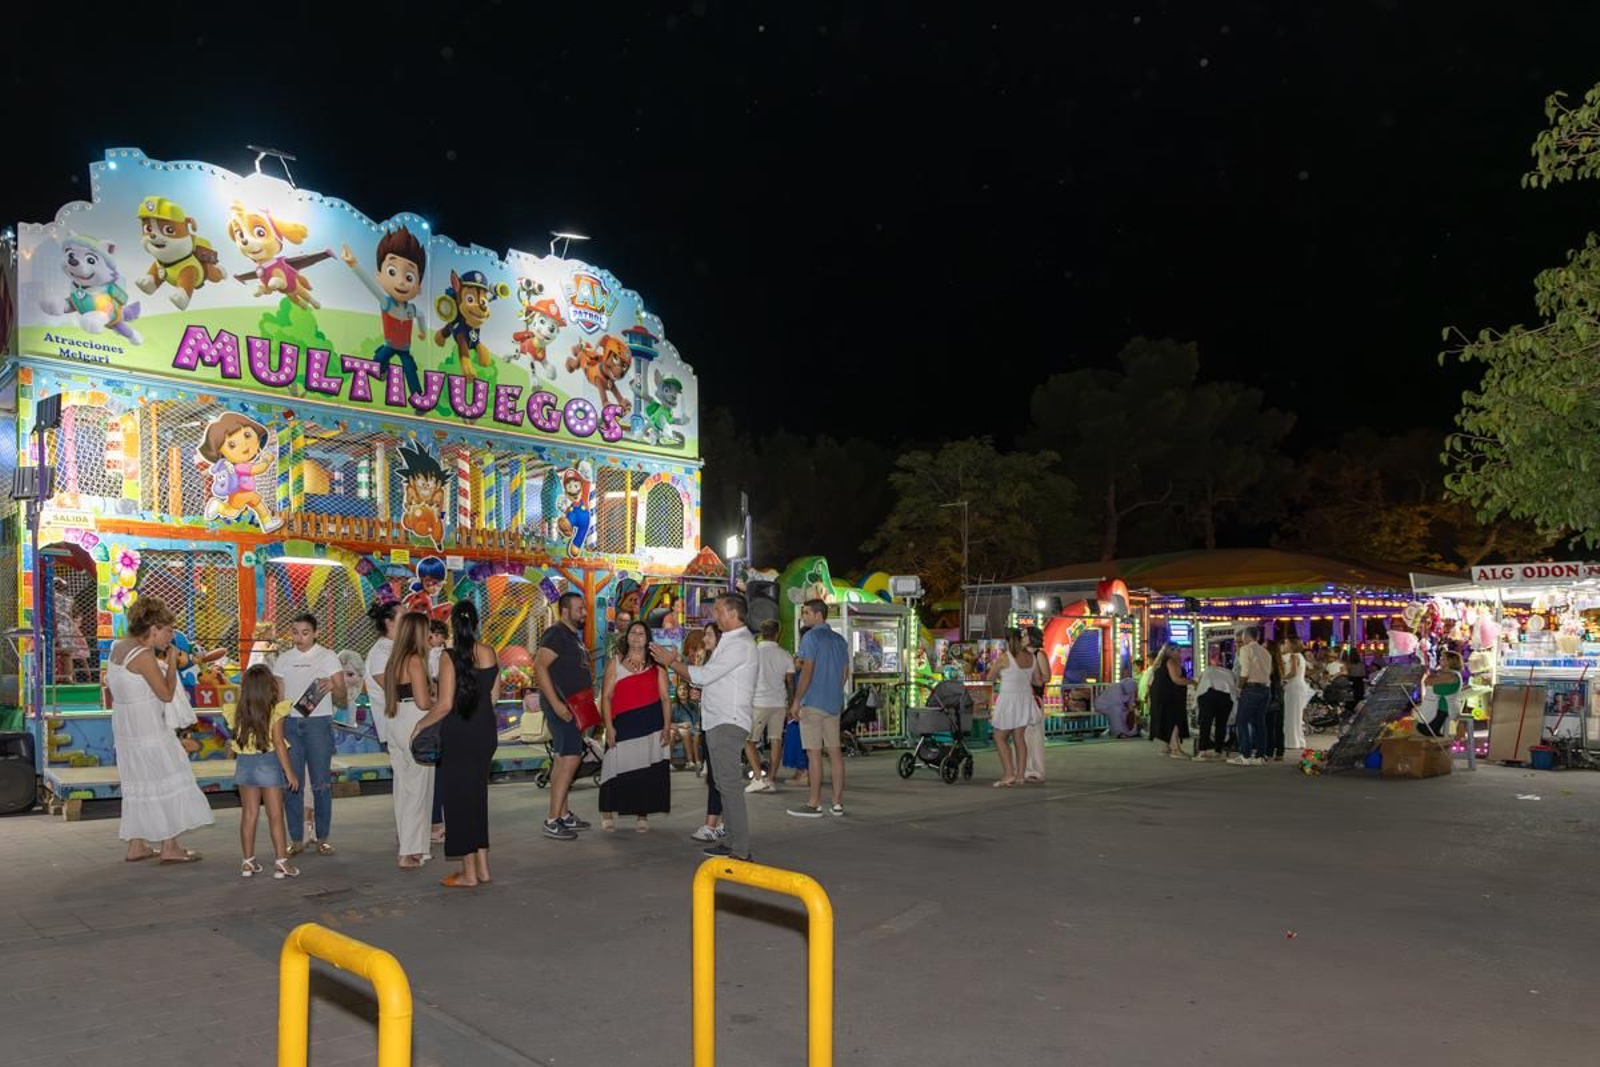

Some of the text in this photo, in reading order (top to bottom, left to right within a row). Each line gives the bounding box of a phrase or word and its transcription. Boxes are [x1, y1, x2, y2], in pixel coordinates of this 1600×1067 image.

[44, 332, 124, 353] Atracciones
[59, 347, 110, 363] Melgari
[172, 325, 625, 442] MULTIJUEGOS
[52, 514, 89, 523] SALIDA
